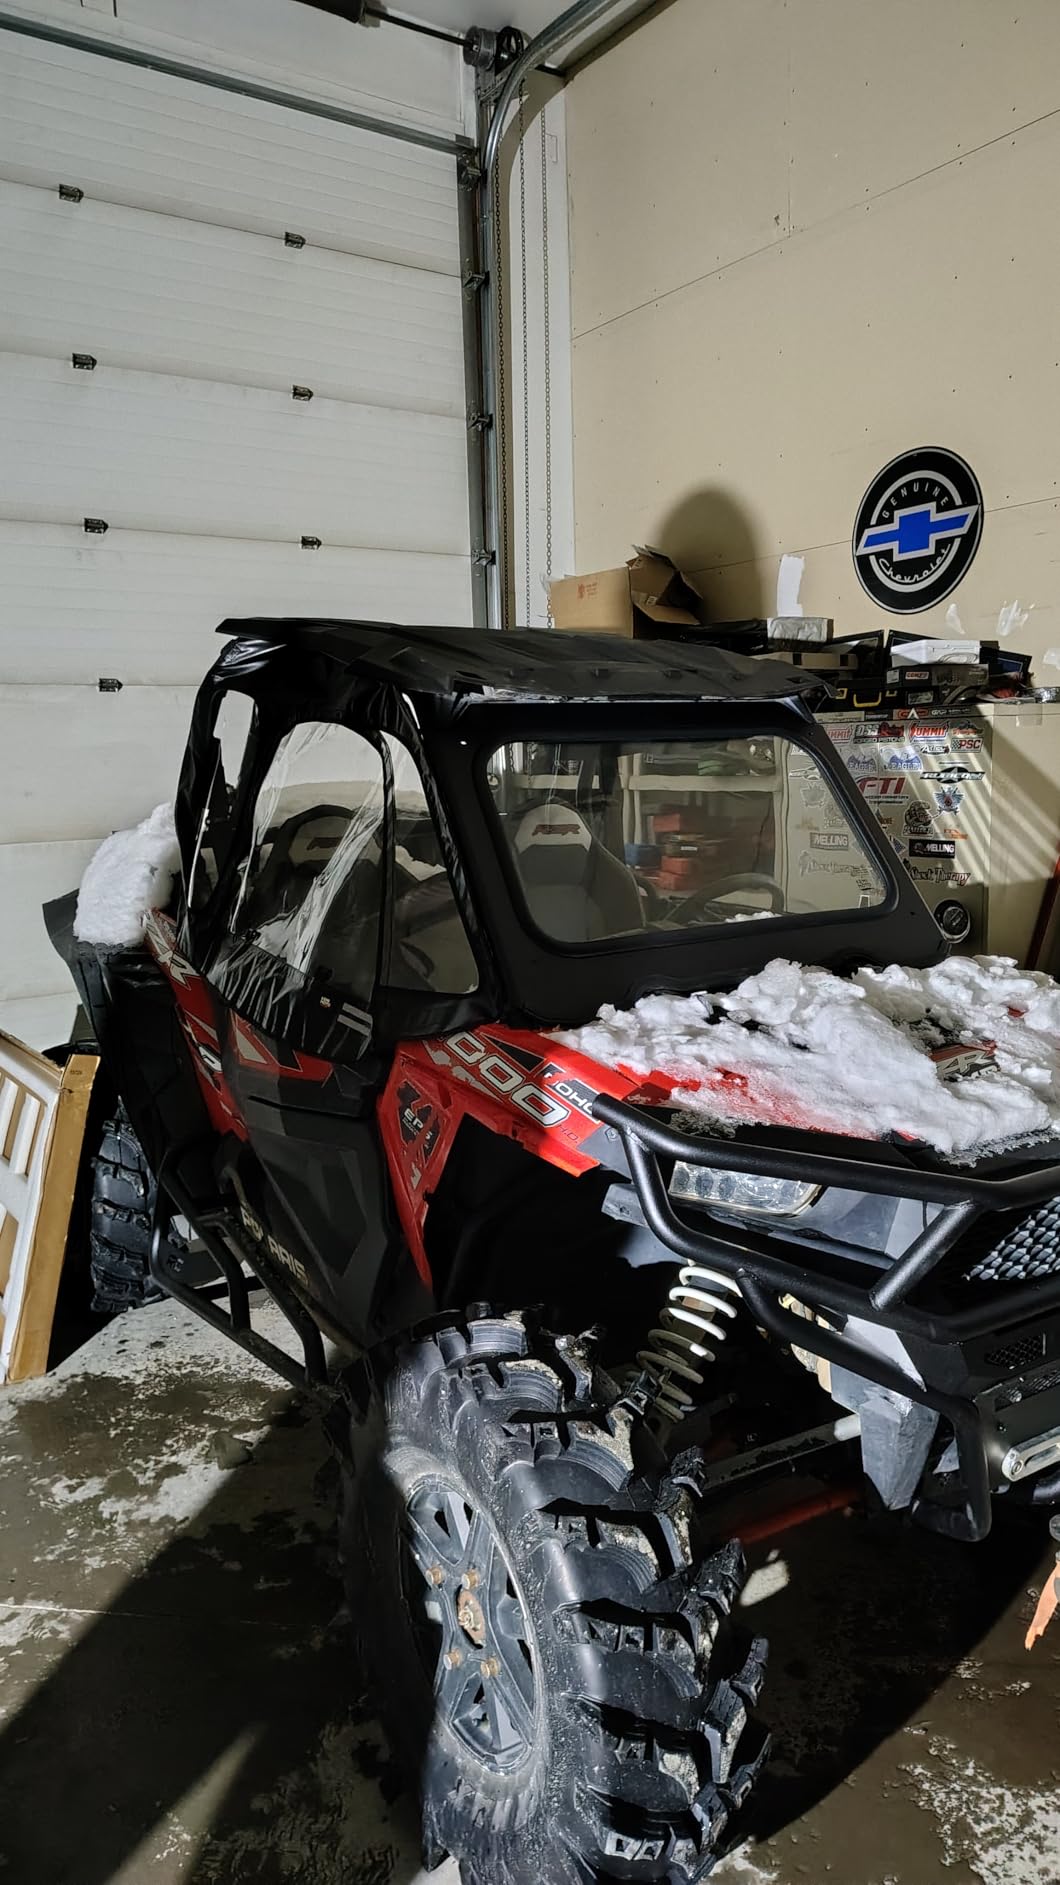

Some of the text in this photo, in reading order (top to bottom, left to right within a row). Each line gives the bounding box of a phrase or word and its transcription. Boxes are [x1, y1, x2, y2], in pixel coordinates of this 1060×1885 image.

[881, 481, 949, 519] GENUINE
[878, 543, 952, 583] Chevrolet
[908, 721, 949, 737] SUMMIT
[959, 739, 981, 749] PSC
[925, 842, 955, 853] MELLING
